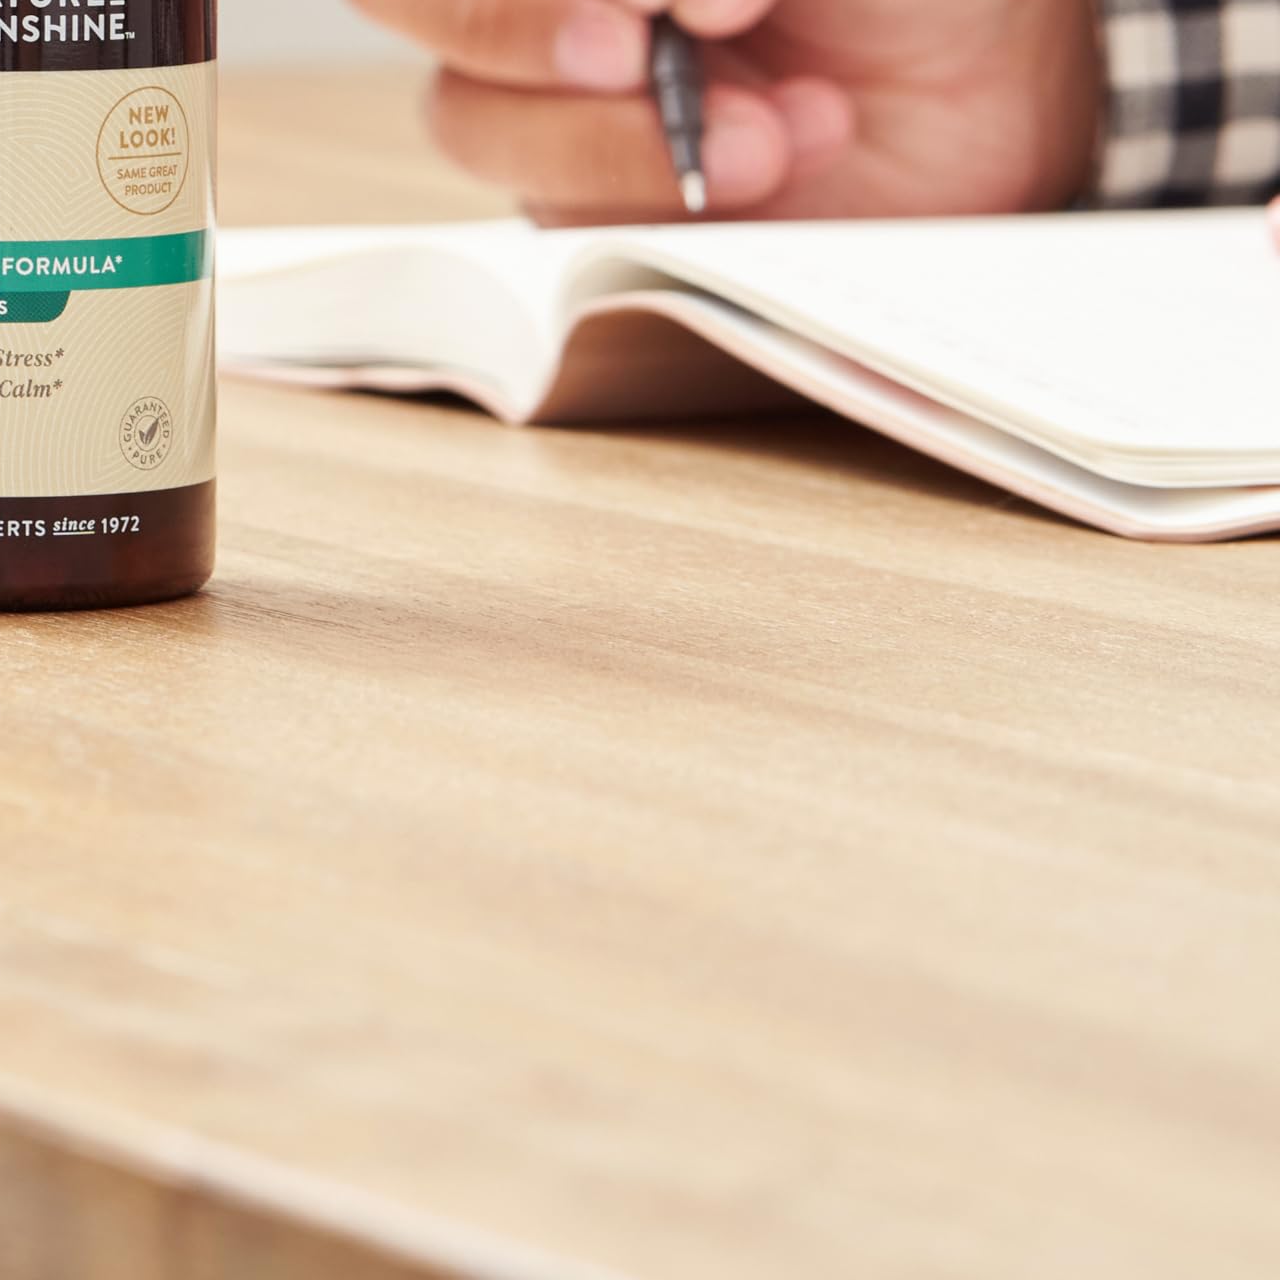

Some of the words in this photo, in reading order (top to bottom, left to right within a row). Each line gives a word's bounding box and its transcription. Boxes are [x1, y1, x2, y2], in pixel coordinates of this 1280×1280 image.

[129, 105, 169, 125] NEW
[119, 128, 176, 149] LOOK!
[116, 165, 147, 180] SAME
[149, 164, 178, 178] GREAT
[124, 182, 172, 196] PRODUCT
[123, 401, 170, 442] GUARANTEED
[132, 449, 163, 466] PURE
[52, 516, 96, 536] since
[101, 515, 140, 534] 1972
